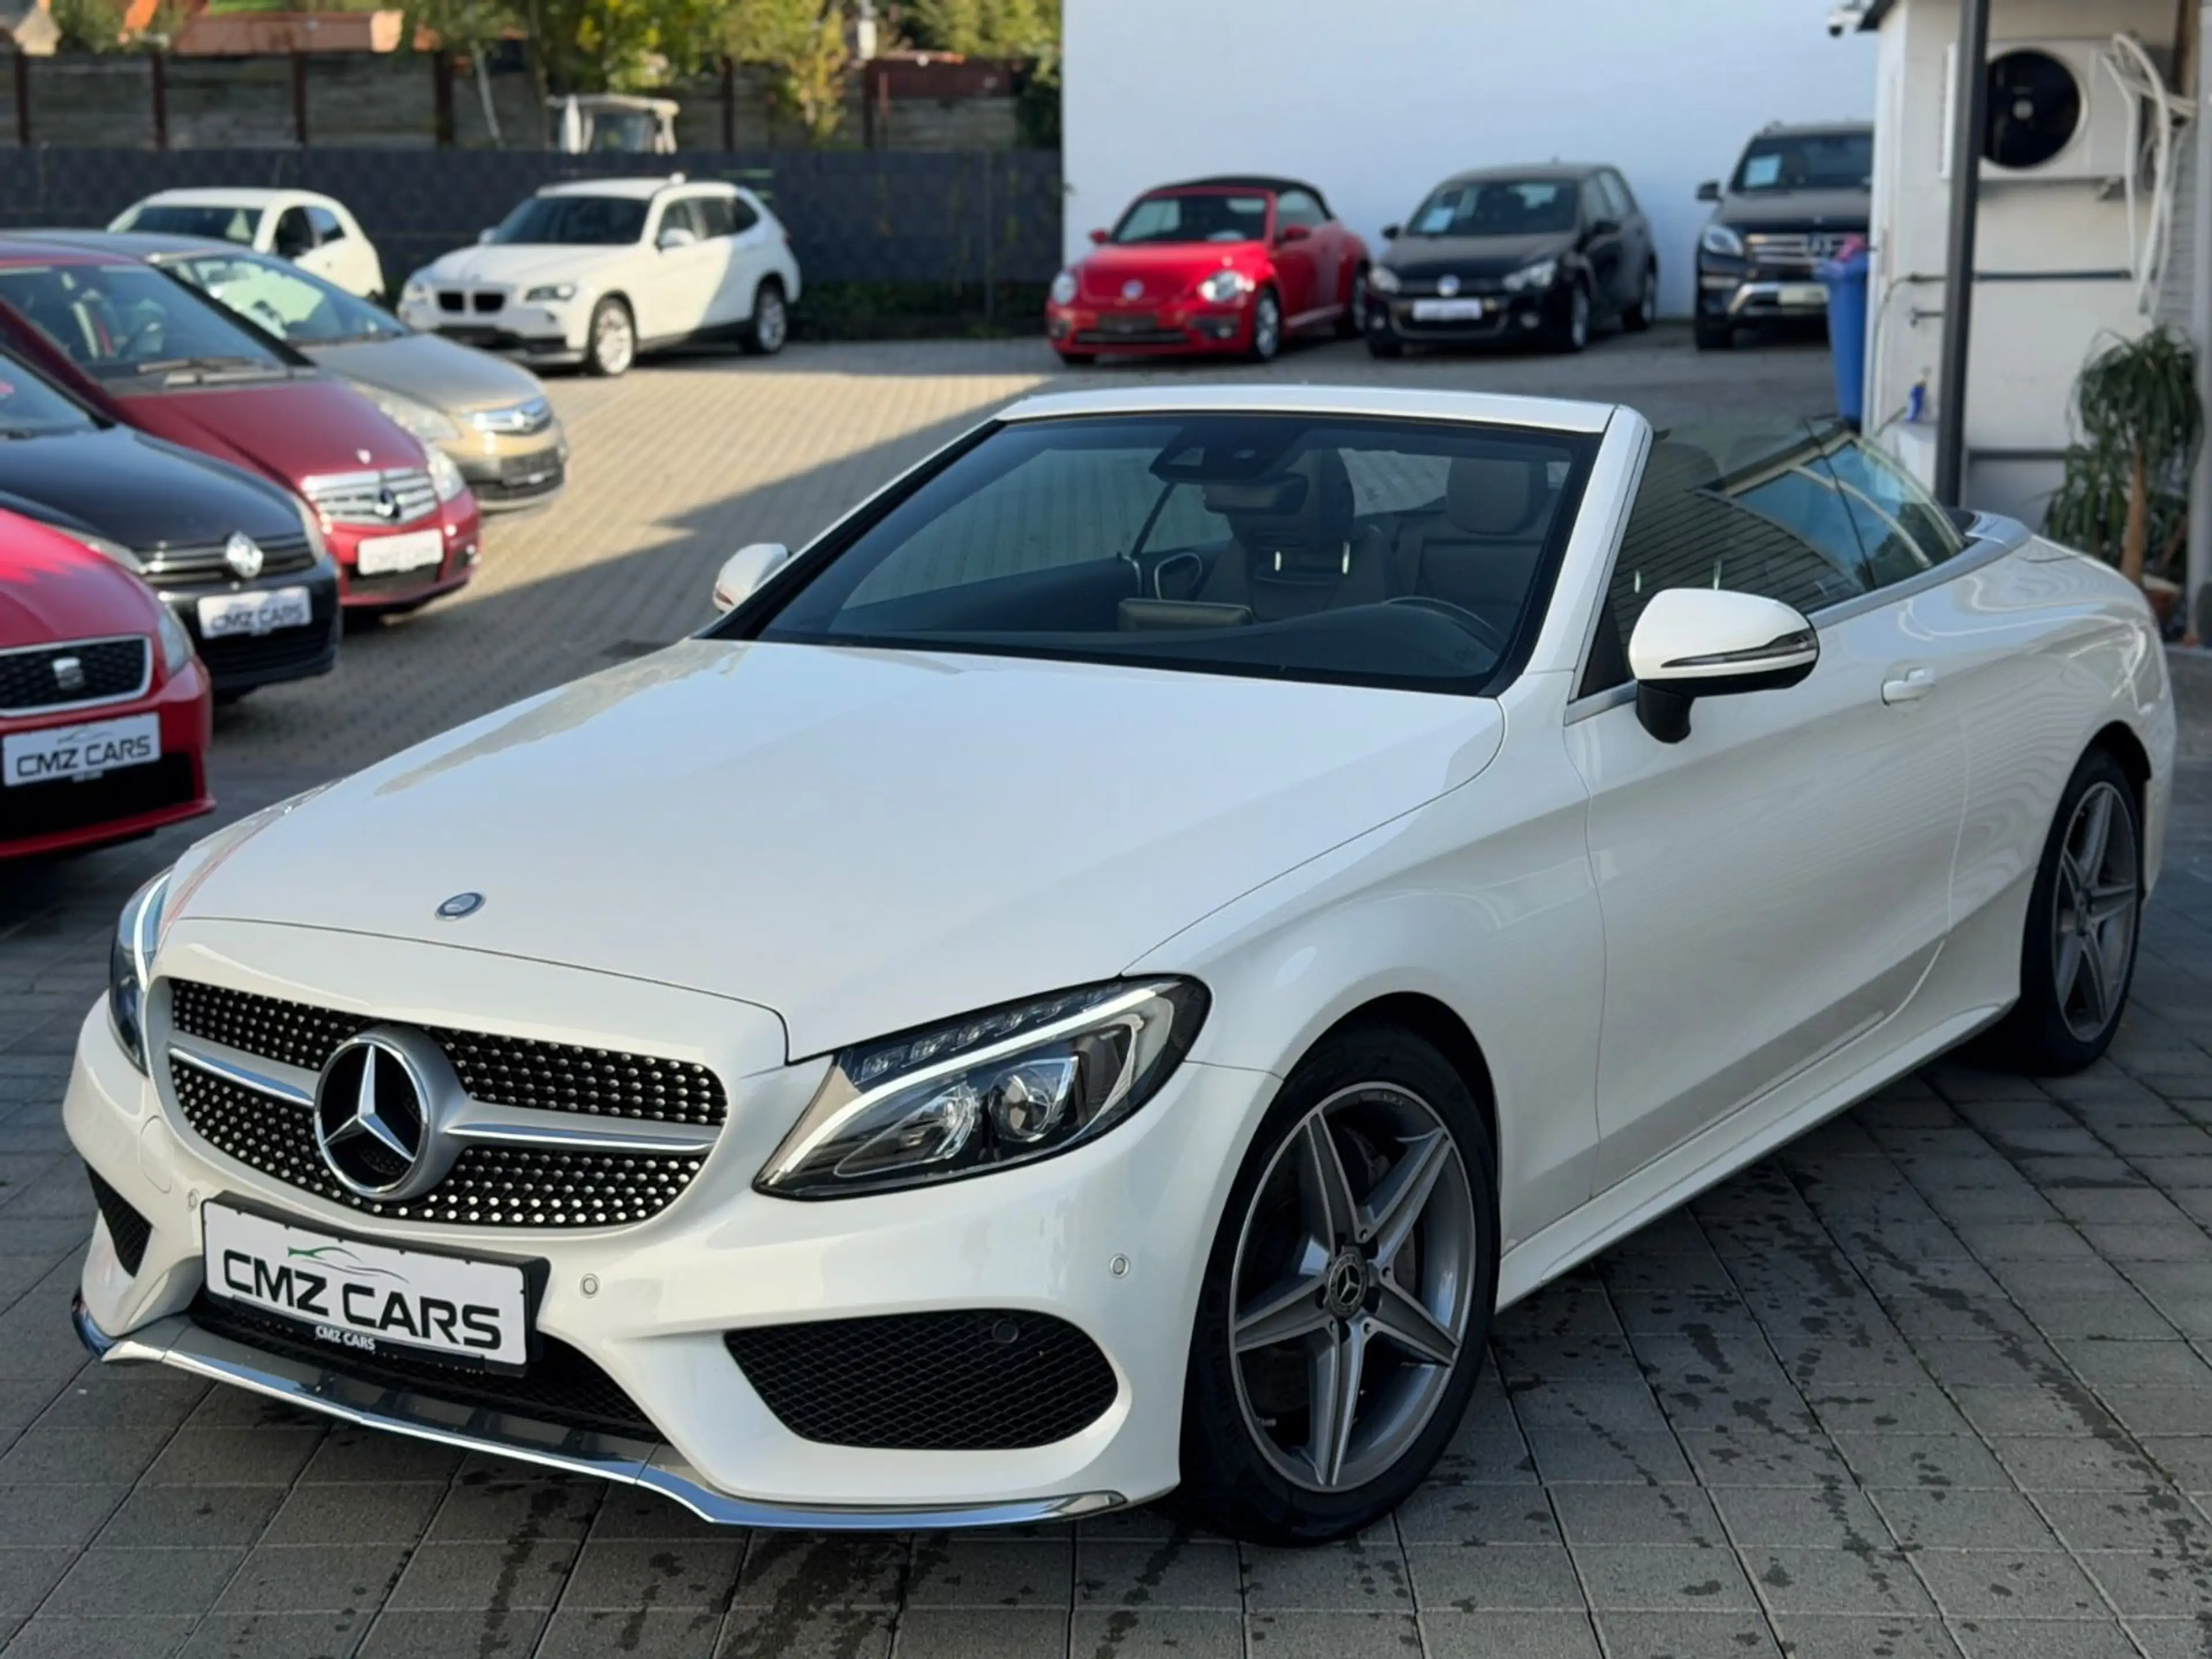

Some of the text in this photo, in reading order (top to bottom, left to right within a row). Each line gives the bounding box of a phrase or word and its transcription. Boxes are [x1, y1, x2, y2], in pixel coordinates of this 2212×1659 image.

[210, 603, 304, 631] CMZ CARS
[17, 735, 151, 777] CMZ CARS
[223, 1248, 502, 1350] CMZ CARS
[315, 1325, 376, 1350] CMZ CARS
